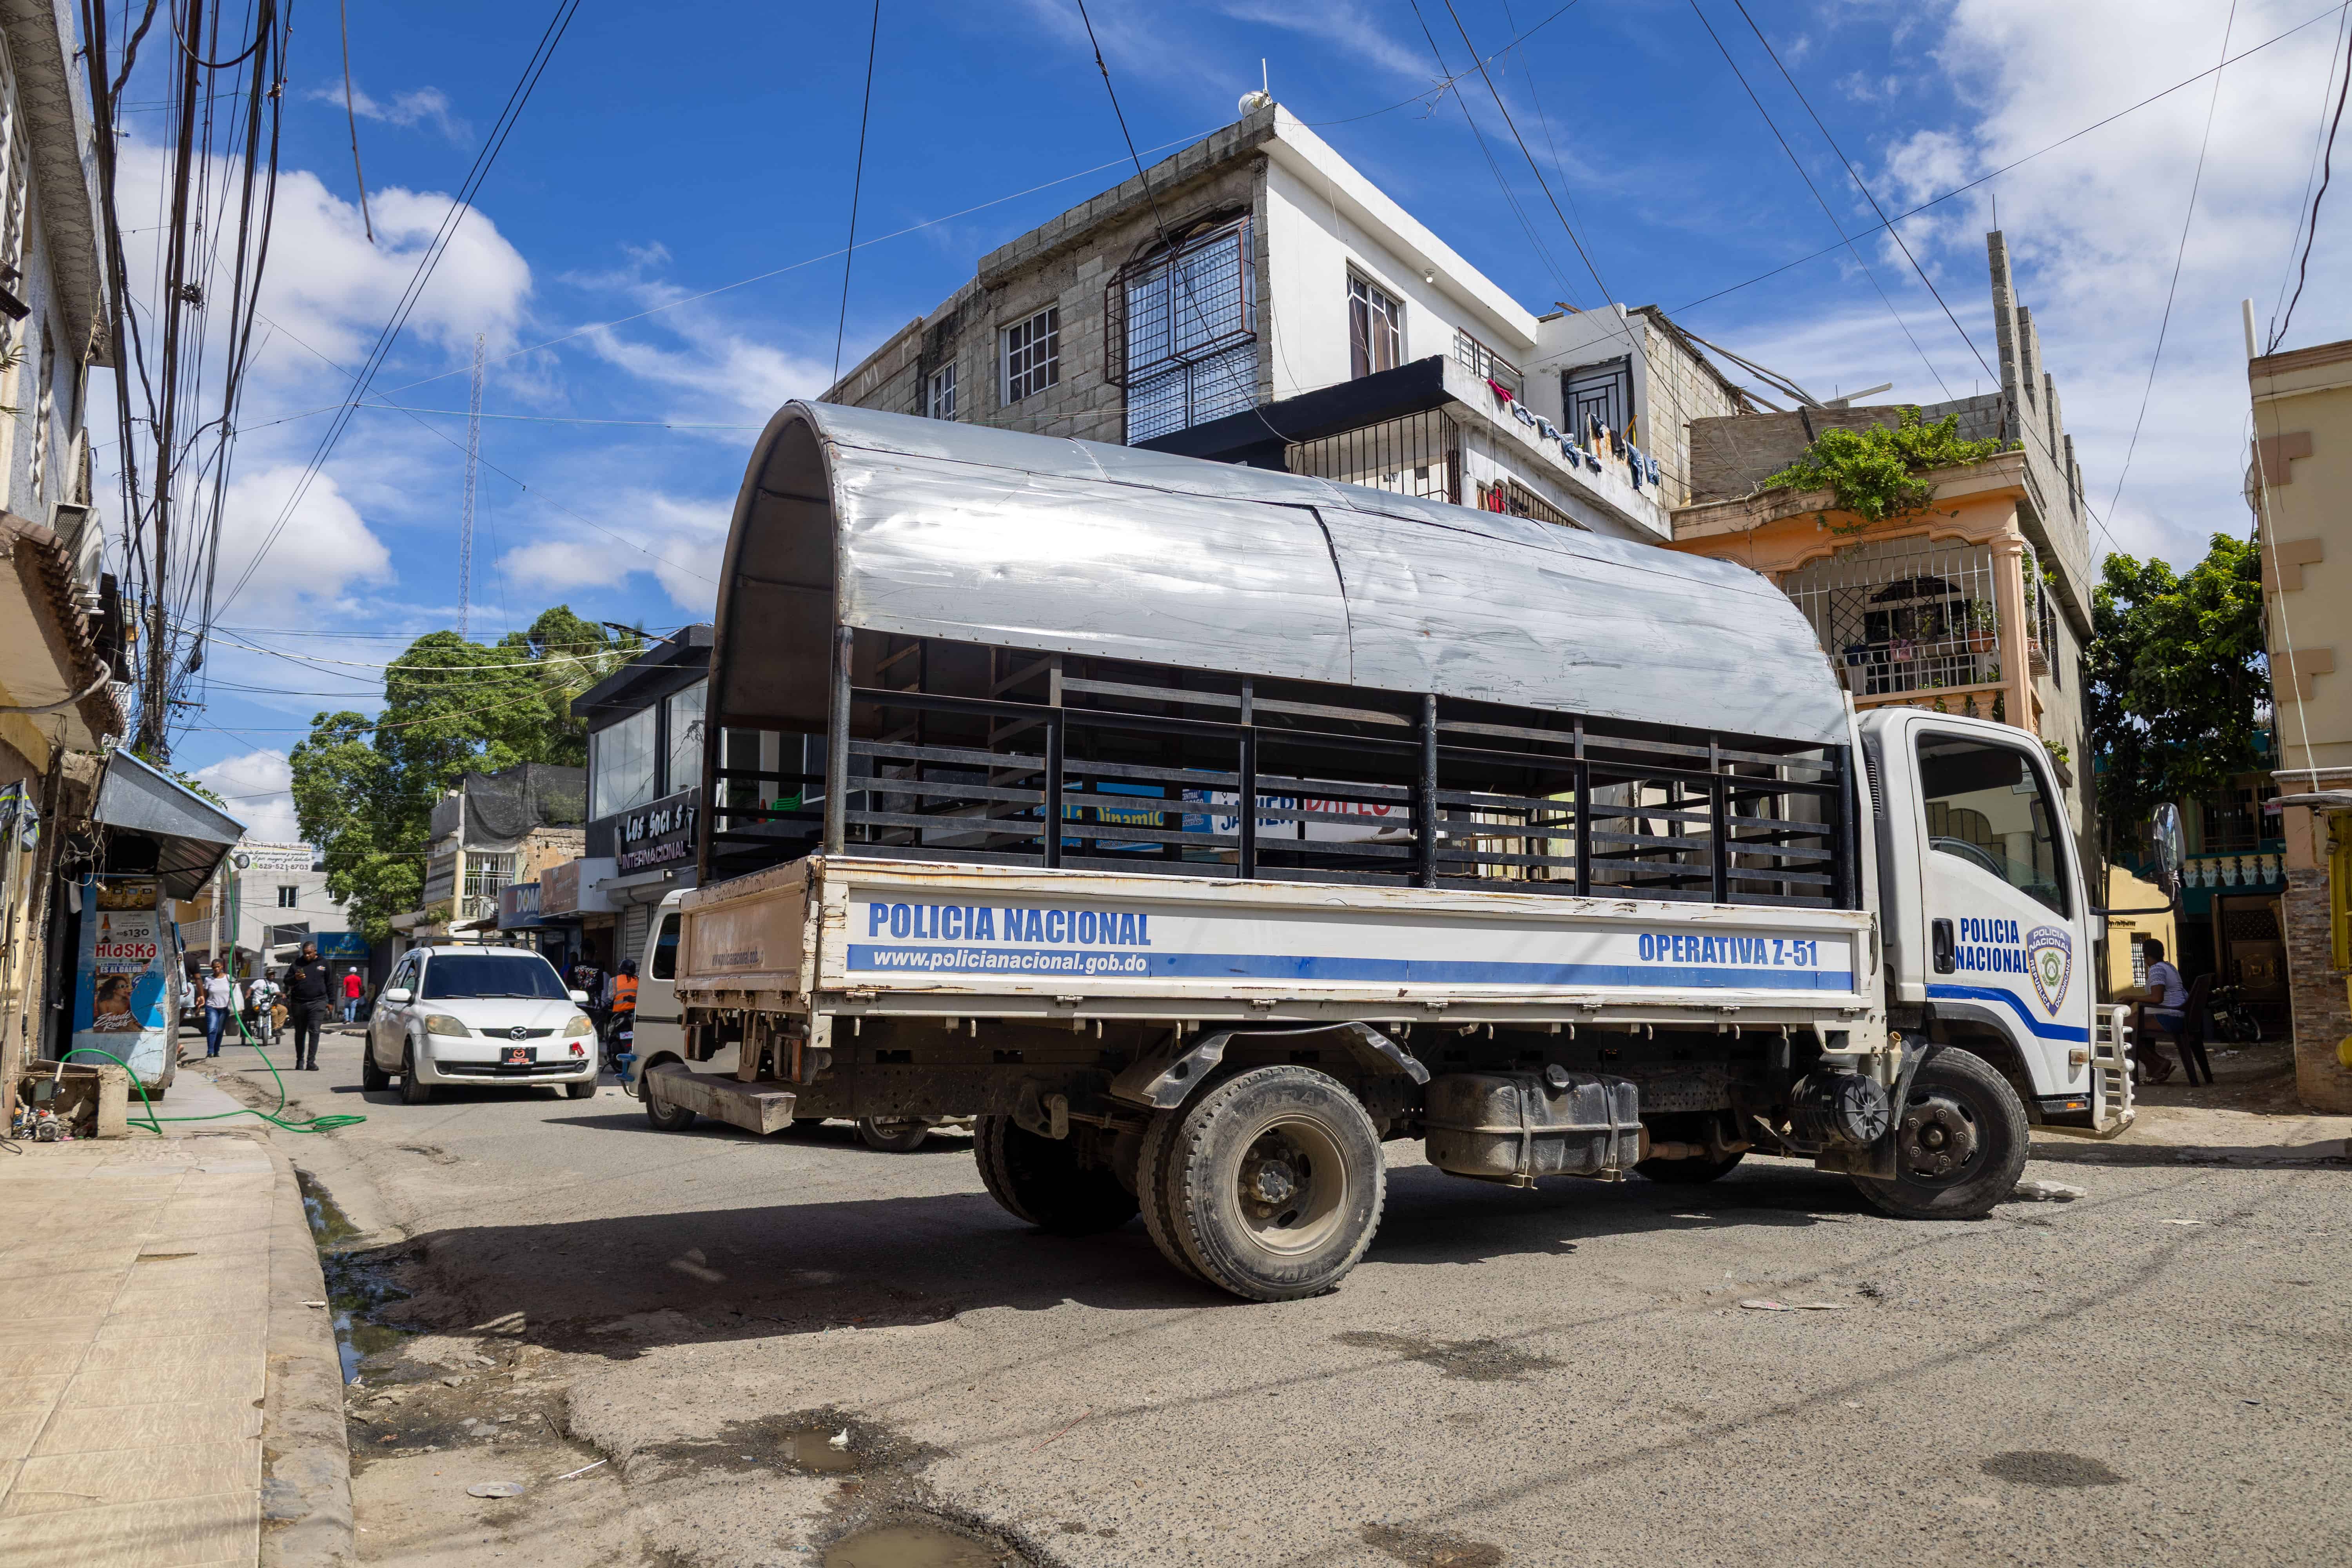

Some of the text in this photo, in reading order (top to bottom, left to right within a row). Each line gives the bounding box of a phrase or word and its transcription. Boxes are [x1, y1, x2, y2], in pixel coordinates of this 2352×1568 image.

[626, 815, 644, 842] LOS
[622, 840, 686, 869] INTERNACIONAL
[869, 903, 1151, 946] POLICIA NACIONAL
[2033, 929, 2065, 941] POLICIA
[1639, 934, 1817, 966] OPERATIVA Z-51
[1955, 918, 2029, 973] POLICIA NACIONAL
[2029, 938, 2071, 955] NACIONAL
[874, 948, 1147, 975] www.policianacional.gob.do
[2030, 959, 2050, 1009] REPUBLICA
[2054, 958, 2071, 1008] DOMINICANA
